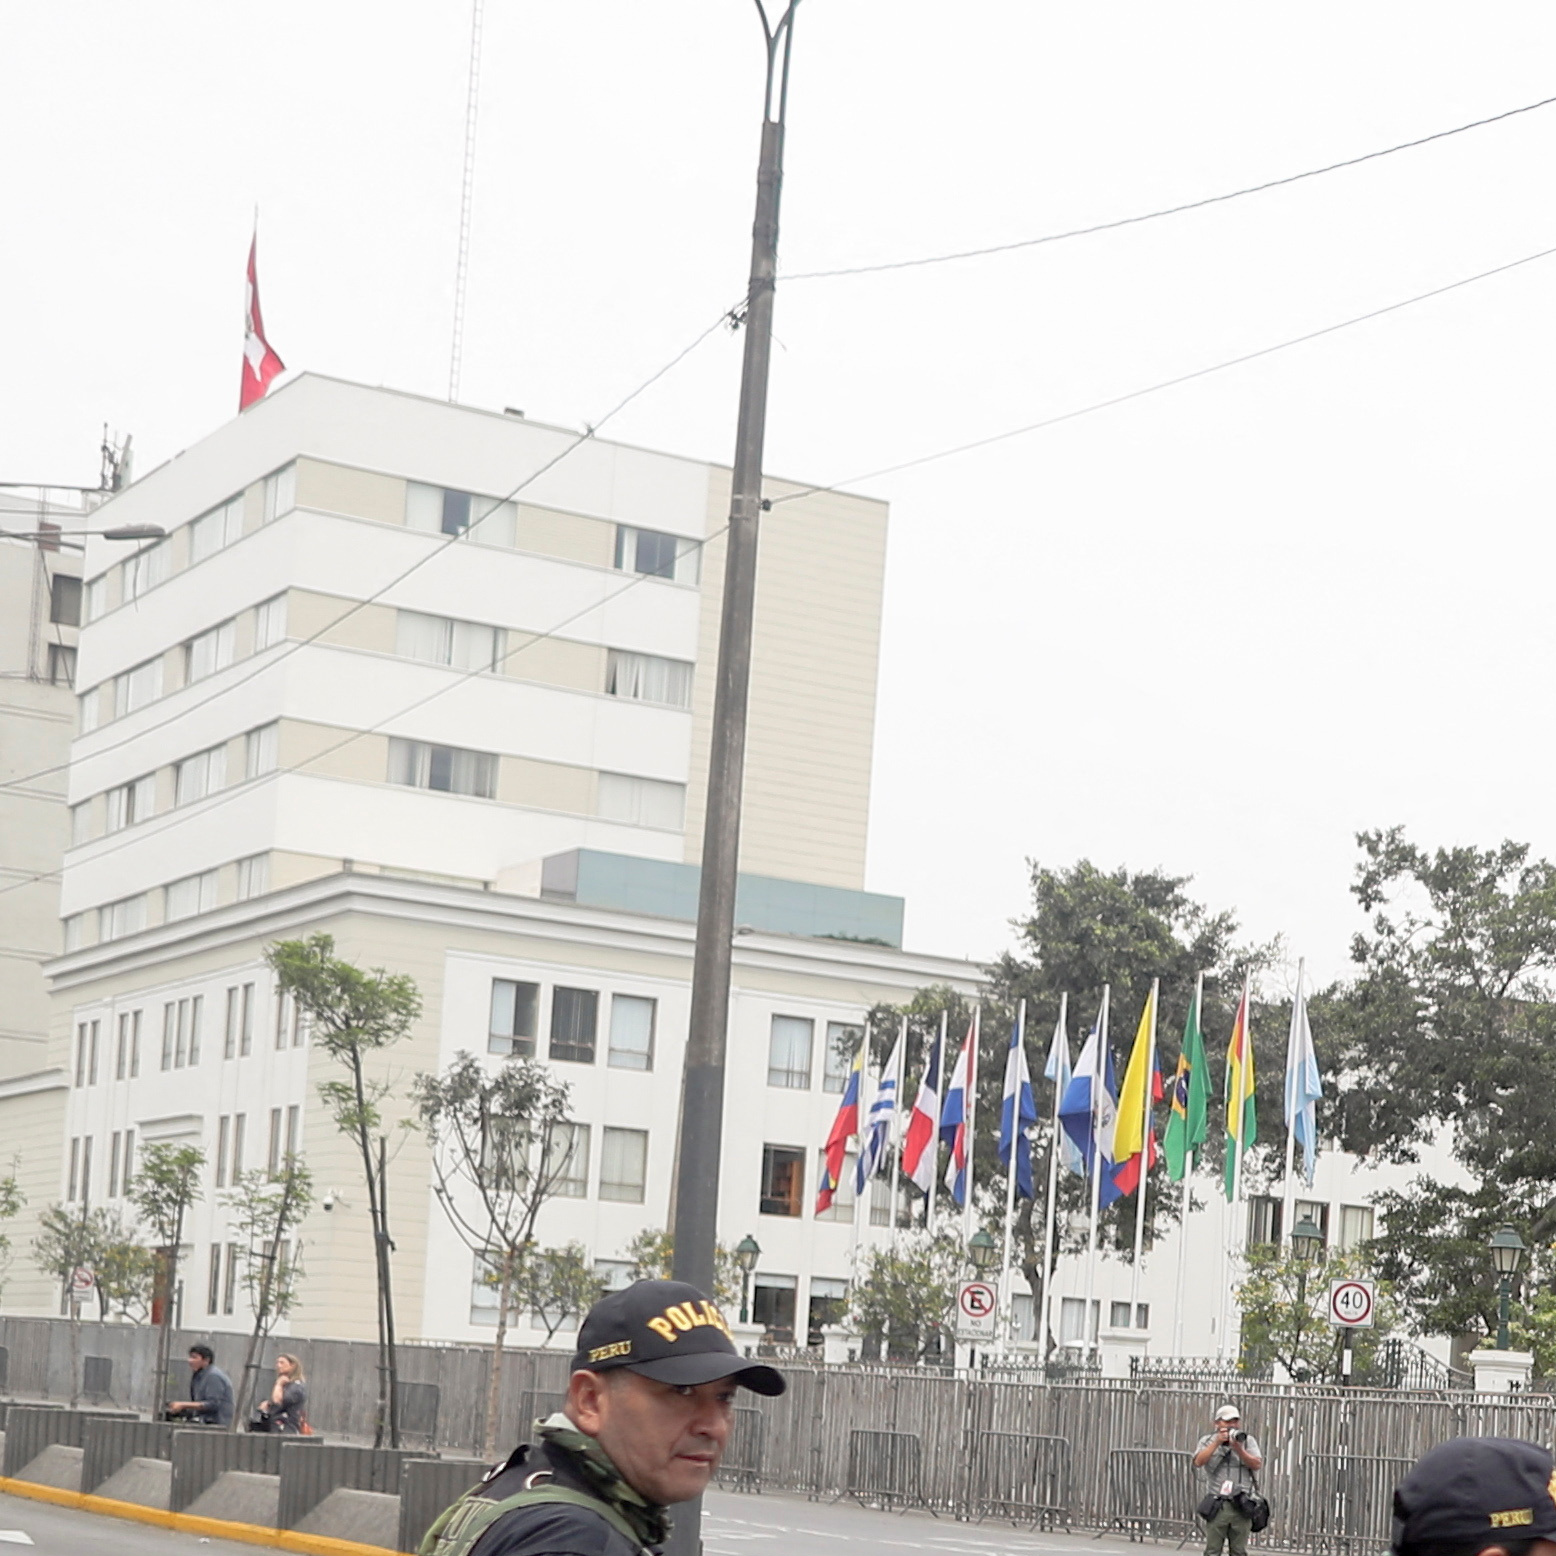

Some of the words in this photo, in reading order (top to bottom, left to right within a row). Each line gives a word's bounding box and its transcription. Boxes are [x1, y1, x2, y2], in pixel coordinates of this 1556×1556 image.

[1340, 1291, 1363, 1309] 40
[589, 1340, 632, 1363] PERU
[1489, 1508, 1534, 1528] PERU
